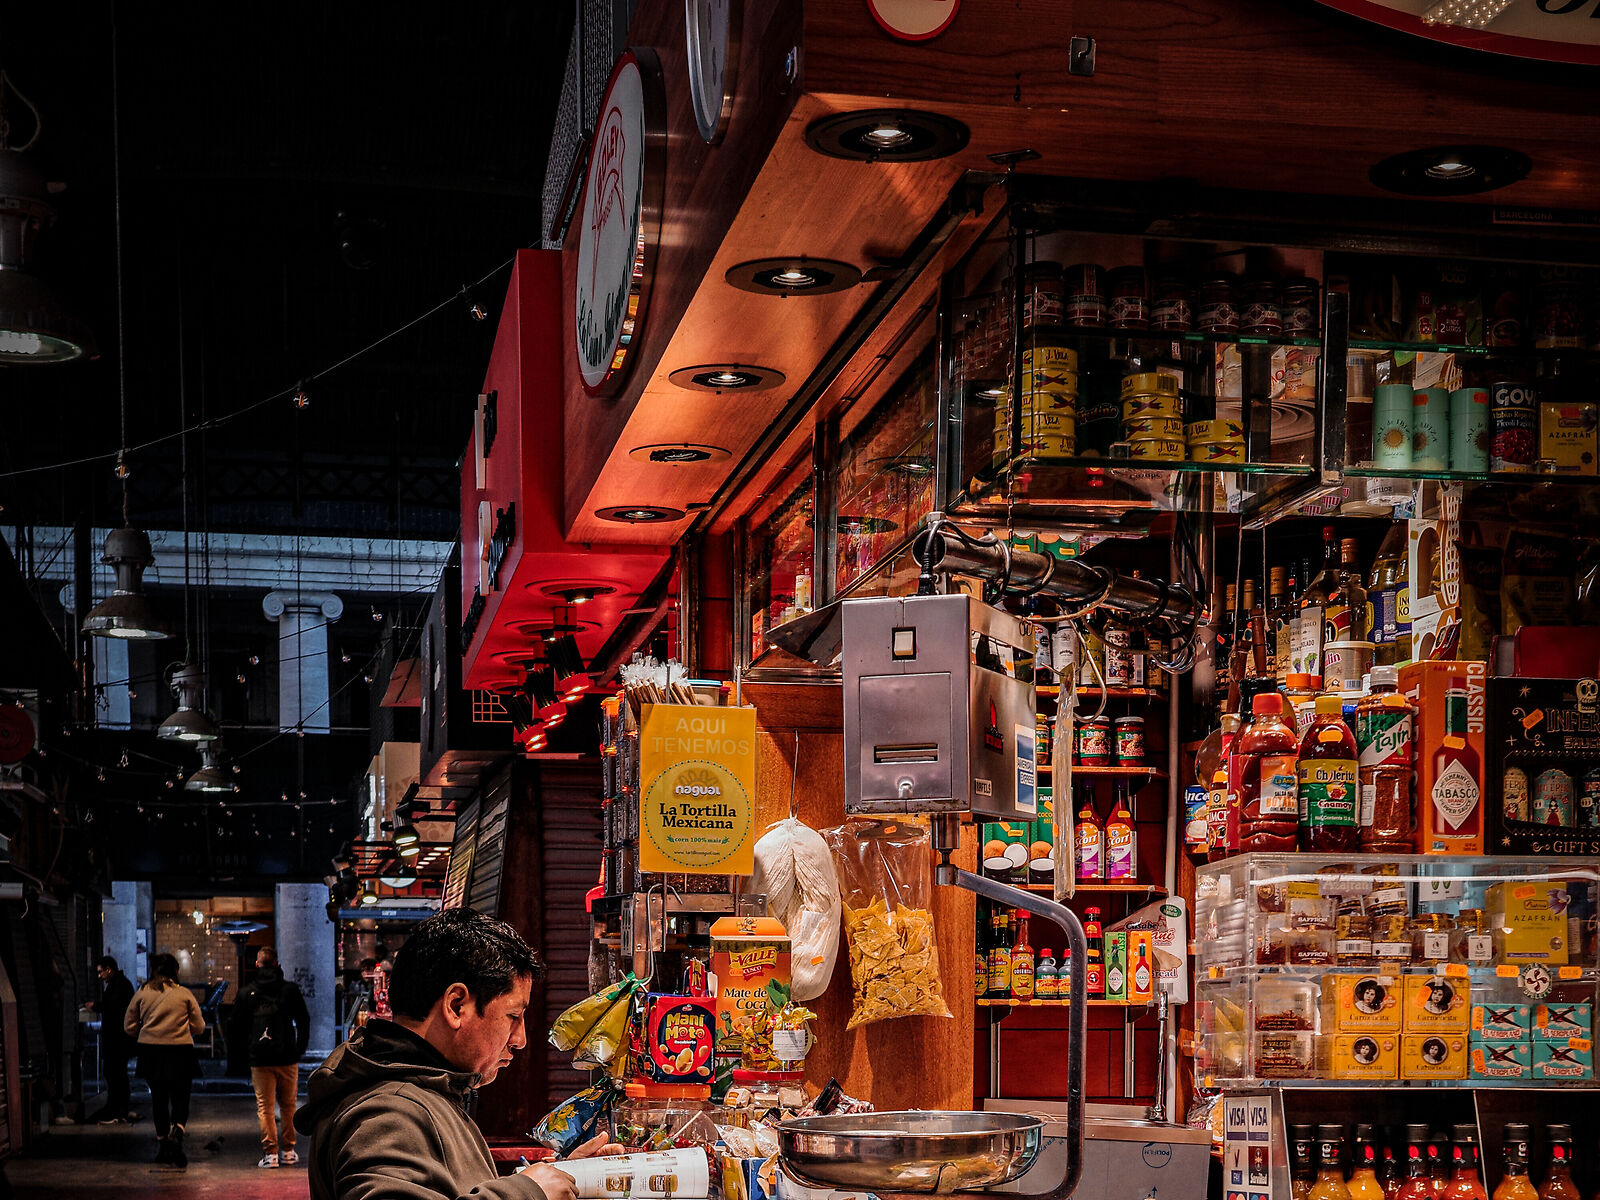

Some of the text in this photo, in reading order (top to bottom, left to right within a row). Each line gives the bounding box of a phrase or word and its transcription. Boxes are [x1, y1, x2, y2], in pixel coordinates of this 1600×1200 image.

[1499, 210, 1552, 221] BARCELONA
[1440, 322, 1446, 334] 2
[1466, 663, 1485, 734] CLASSIC
[675, 715, 726, 734] AQUÍ
[651, 737, 750, 755] TENEMOS
[675, 785, 721, 797] nagual
[1434, 788, 1477, 799] TABASCO
[660, 803, 736, 817] La Tortilla
[662, 816, 733, 829] Mexicana
[1553, 841, 1587, 853] GIFT
[1152, 929, 1175, 940] aní
[739, 949, 776, 966] VALLE
[743, 966, 762, 975] CUSCO
[724, 987, 767, 998] Mate de
[736, 999, 767, 1010] Coca
[667, 1013, 705, 1027] Maní
[665, 1026, 705, 1040] Moto
[1229, 1107, 1268, 1126] VISA VISA
